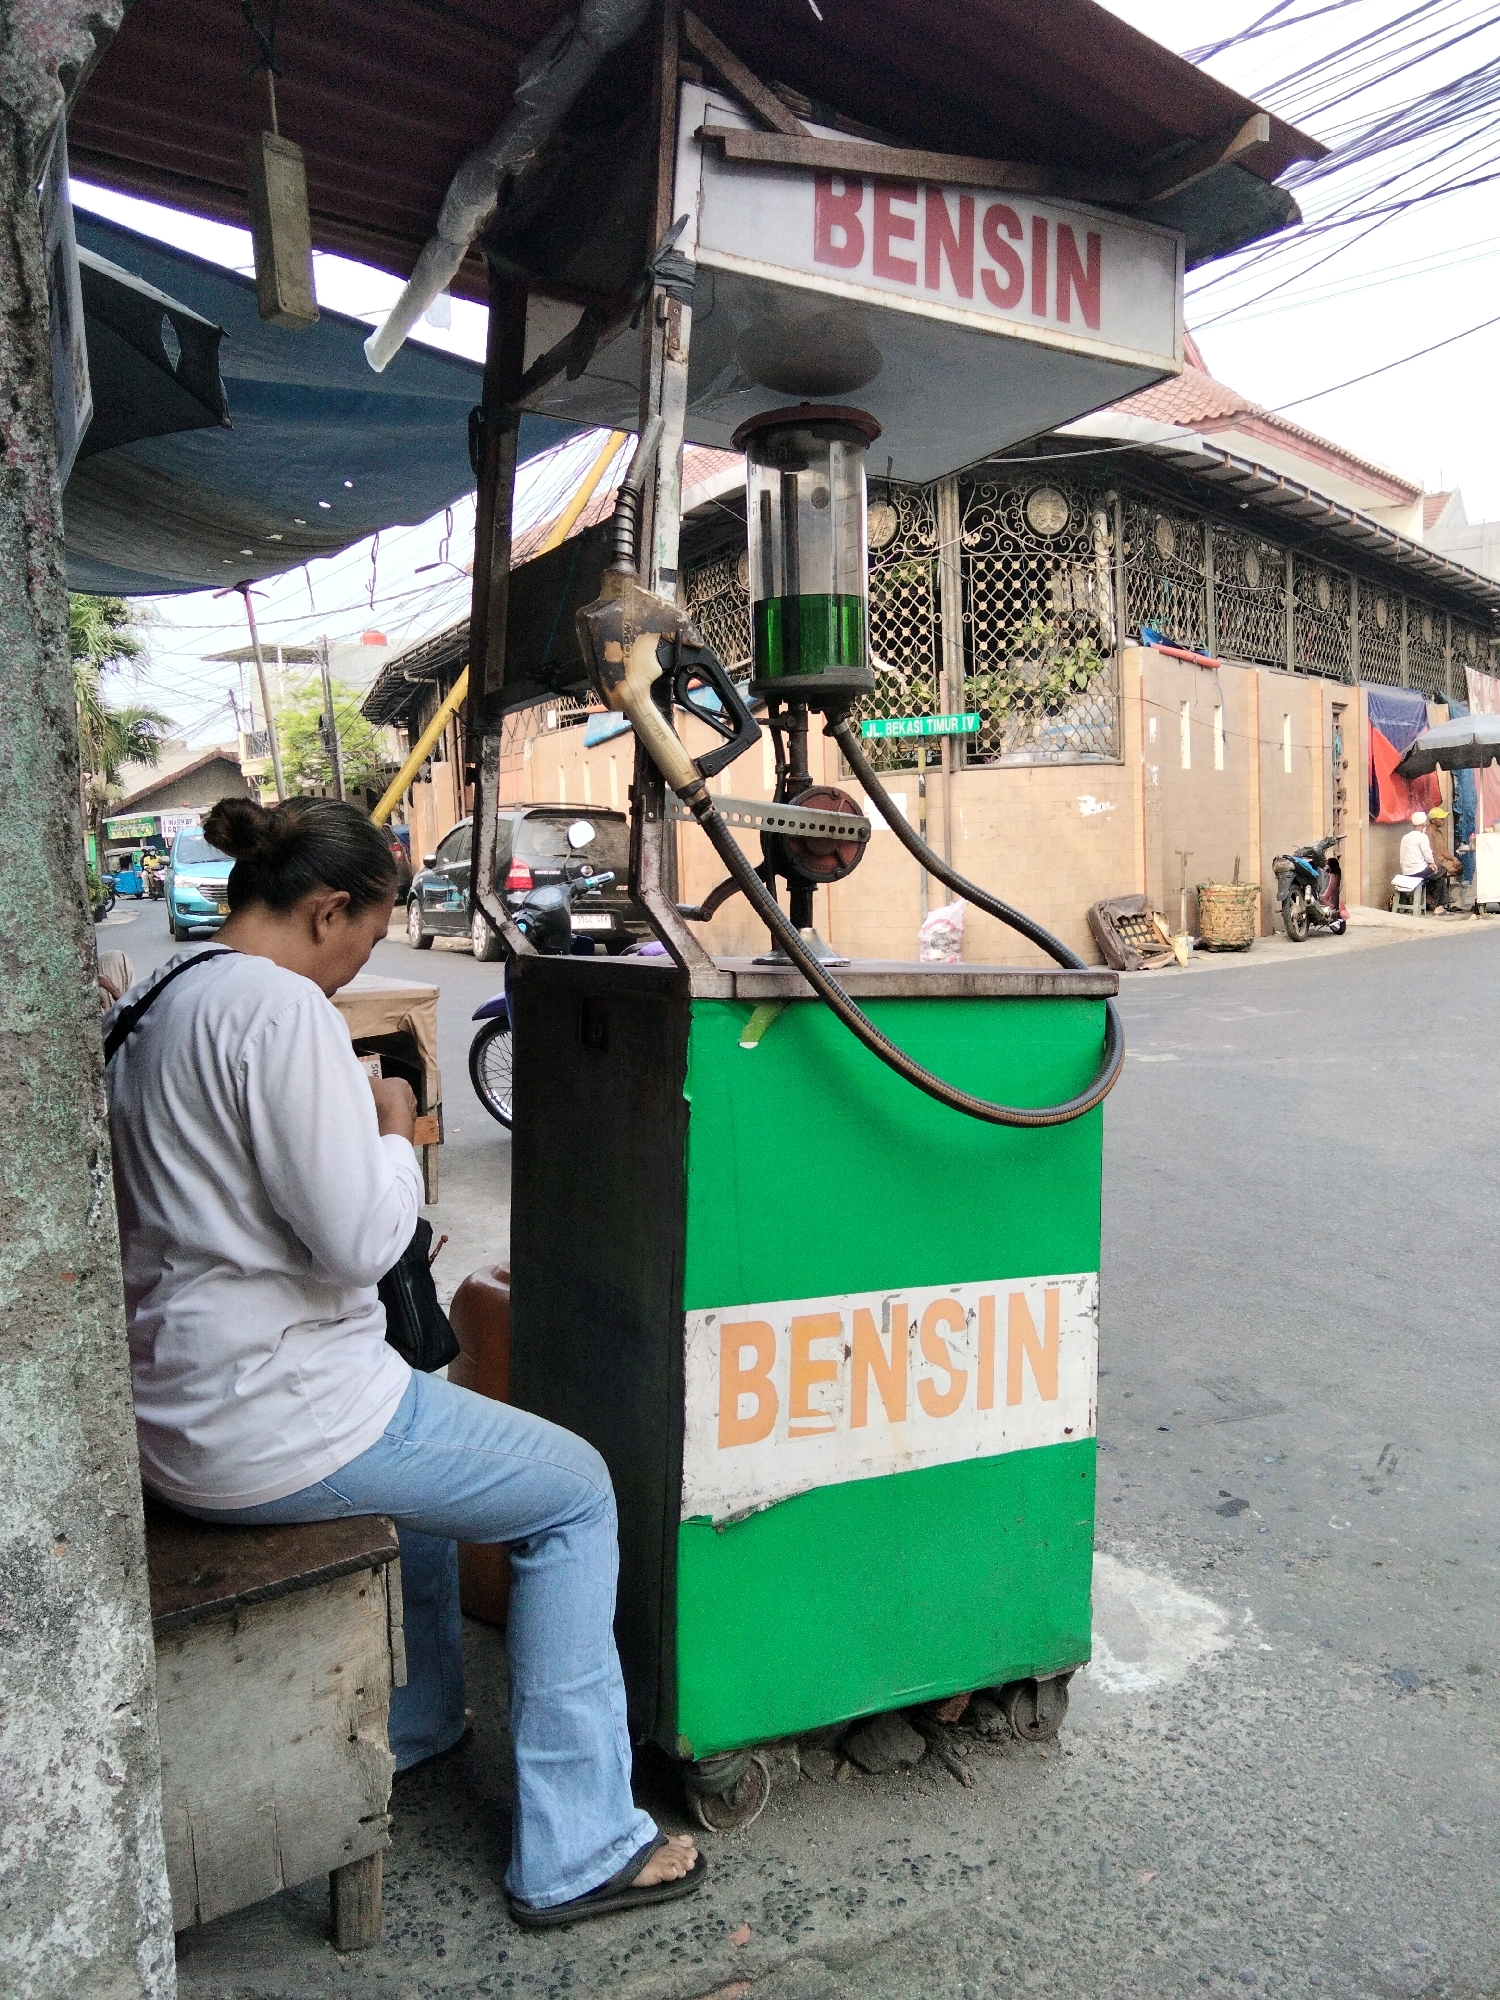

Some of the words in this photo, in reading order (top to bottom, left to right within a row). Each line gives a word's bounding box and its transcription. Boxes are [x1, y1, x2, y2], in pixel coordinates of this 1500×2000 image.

[814, 168, 1101, 331] BENSIN
[866, 723, 882, 738] JL.
[885, 720, 923, 737] BEKASI
[926, 717, 959, 733] TIMUR
[961, 715, 975, 731] IV
[718, 1288, 1060, 1449] BENSIN
